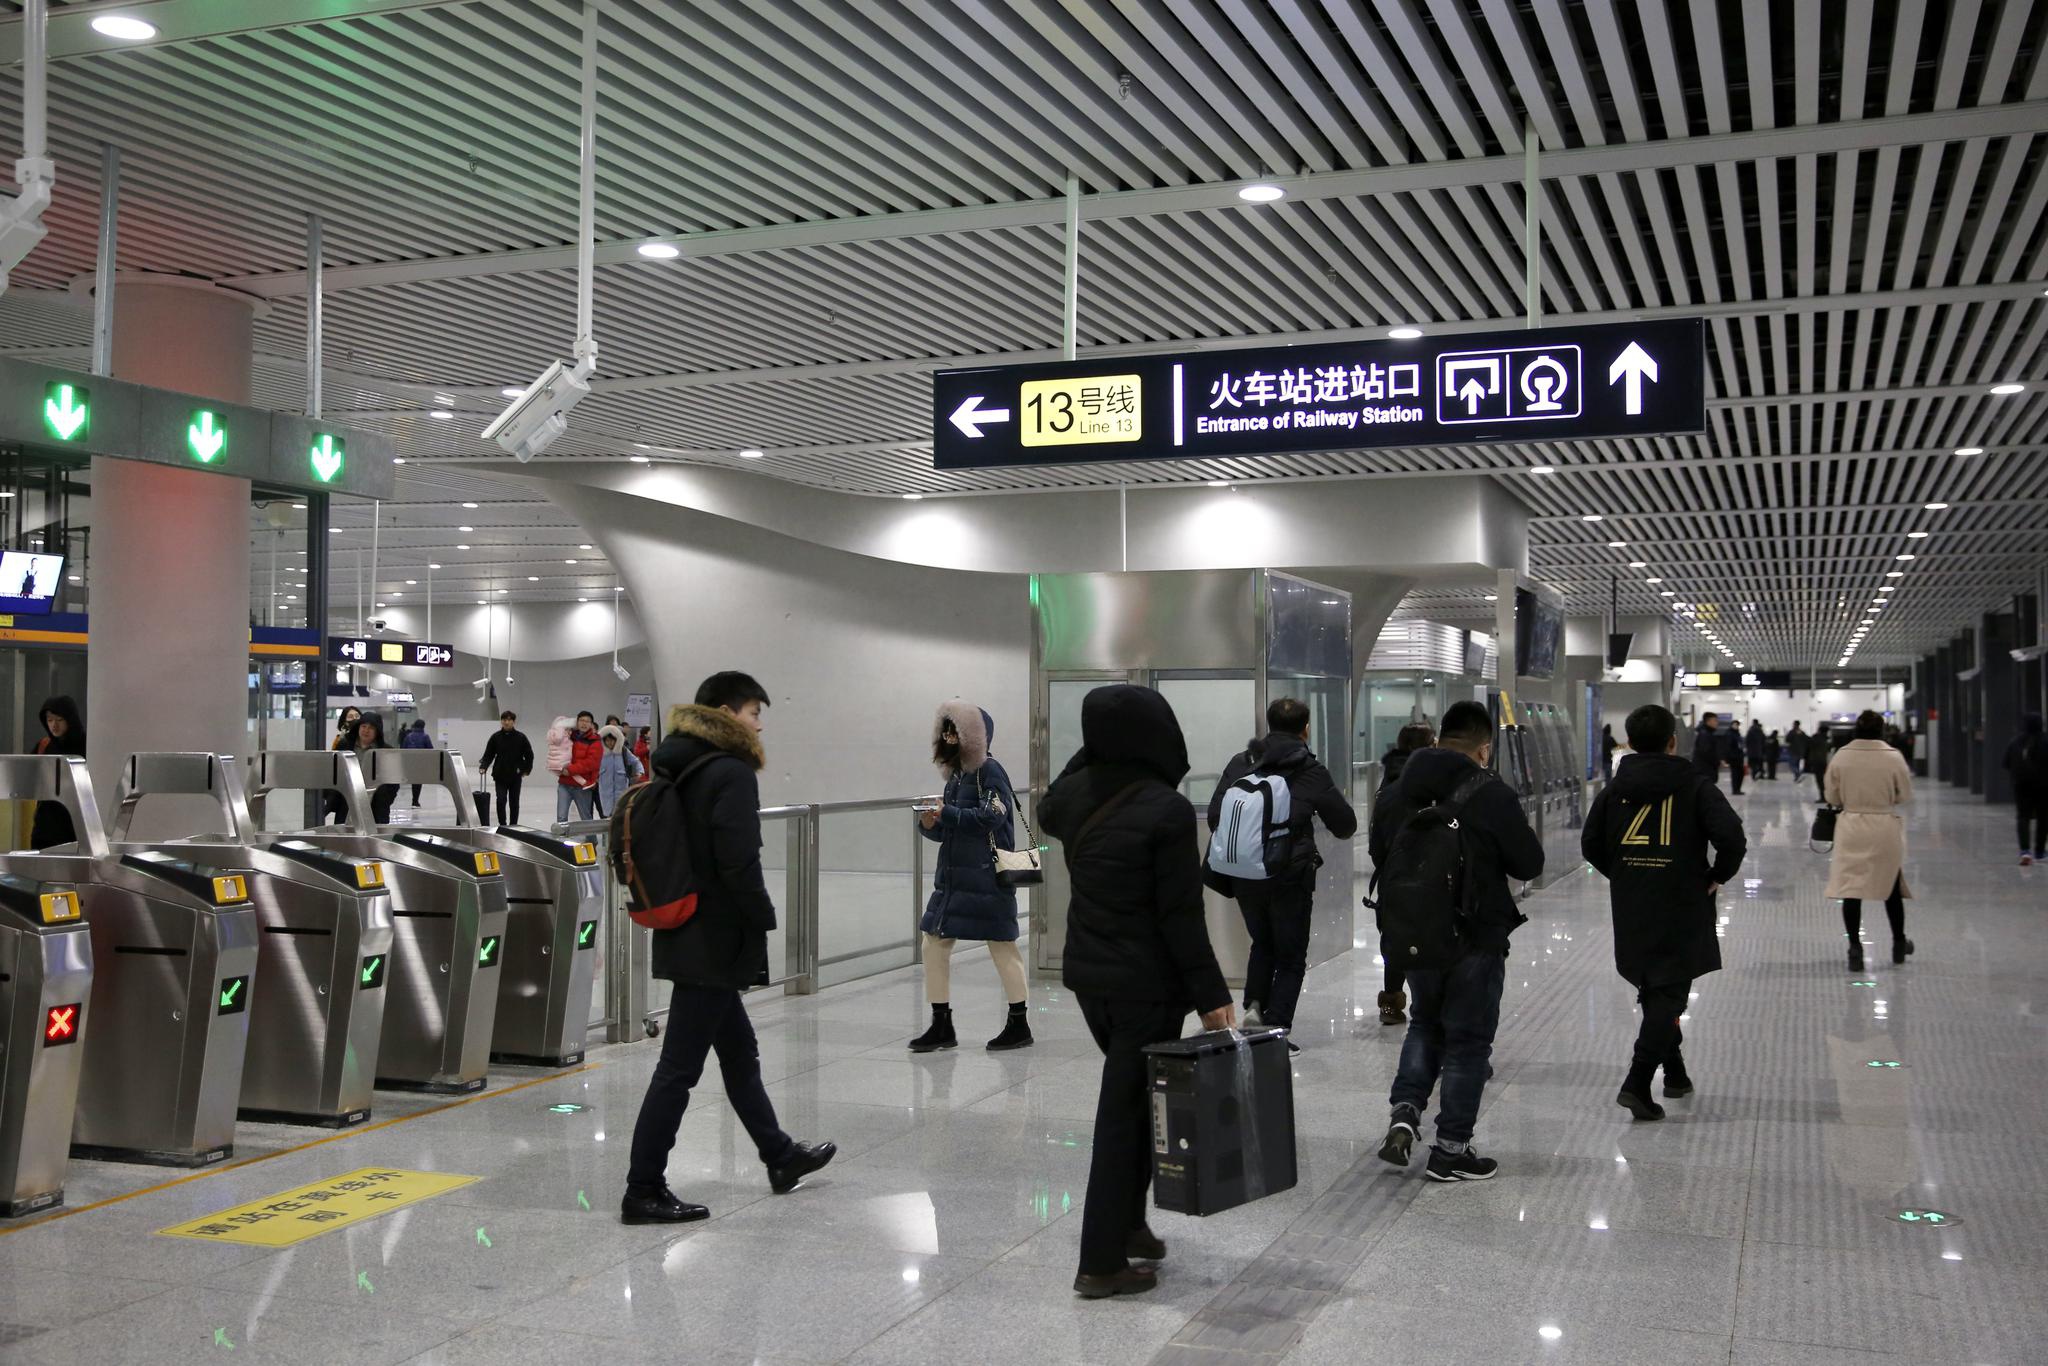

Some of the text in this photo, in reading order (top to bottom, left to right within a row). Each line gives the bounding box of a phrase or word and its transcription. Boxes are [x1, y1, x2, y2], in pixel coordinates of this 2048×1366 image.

[1209, 363, 1419, 410] 火车站进站口
[1080, 419, 1133, 434] Line 13
[1197, 406, 1423, 433] Entrance of Railway Station
